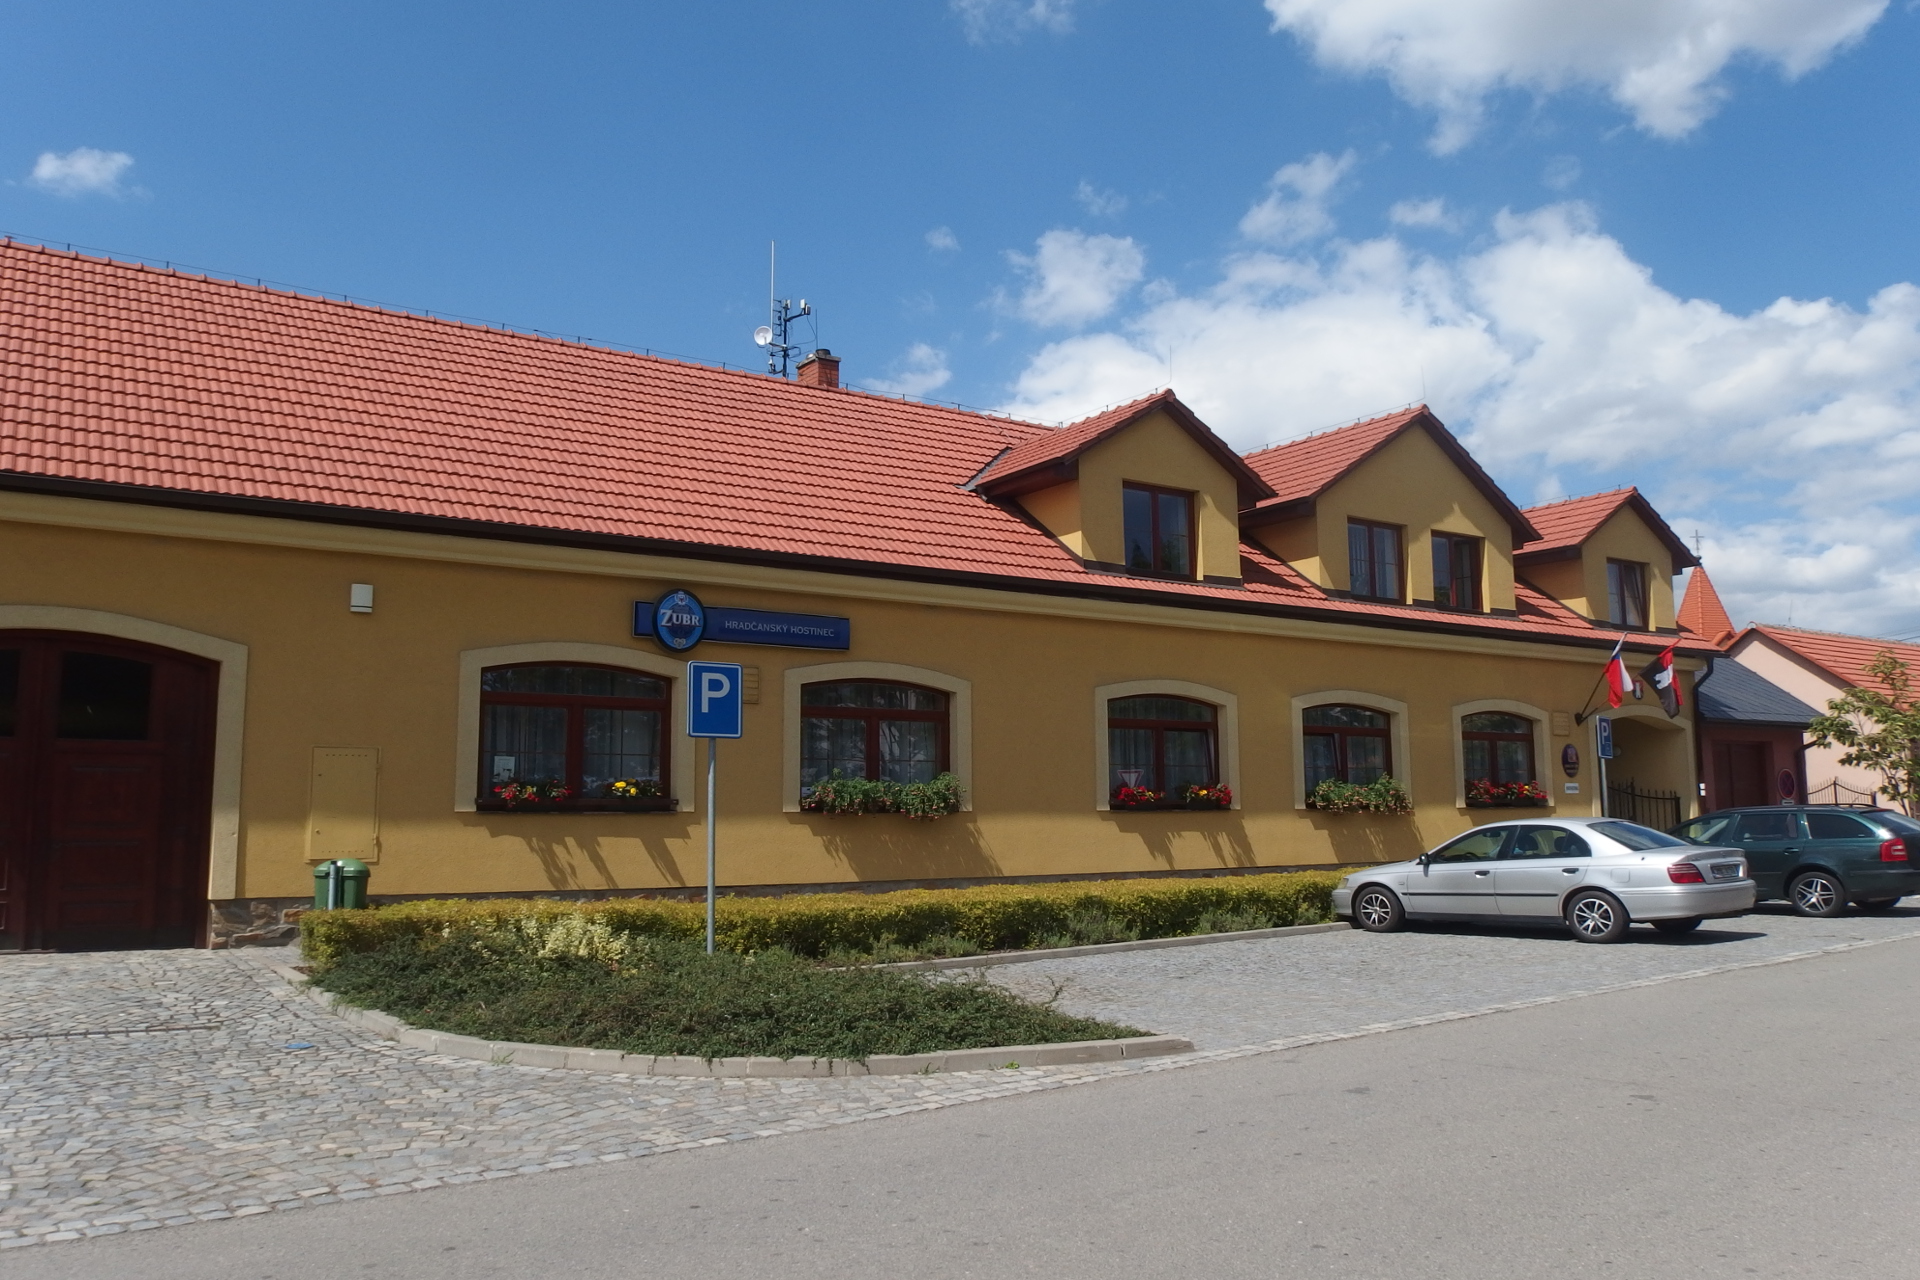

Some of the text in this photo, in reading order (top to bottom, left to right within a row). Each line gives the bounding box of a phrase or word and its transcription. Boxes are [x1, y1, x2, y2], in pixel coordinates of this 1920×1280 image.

[660, 609, 700, 626] ZUBR
[725, 620, 834, 637] HRADČANSKÝ HOSTINEC
[701, 672, 731, 713] P
[1601, 722, 1609, 745] P
